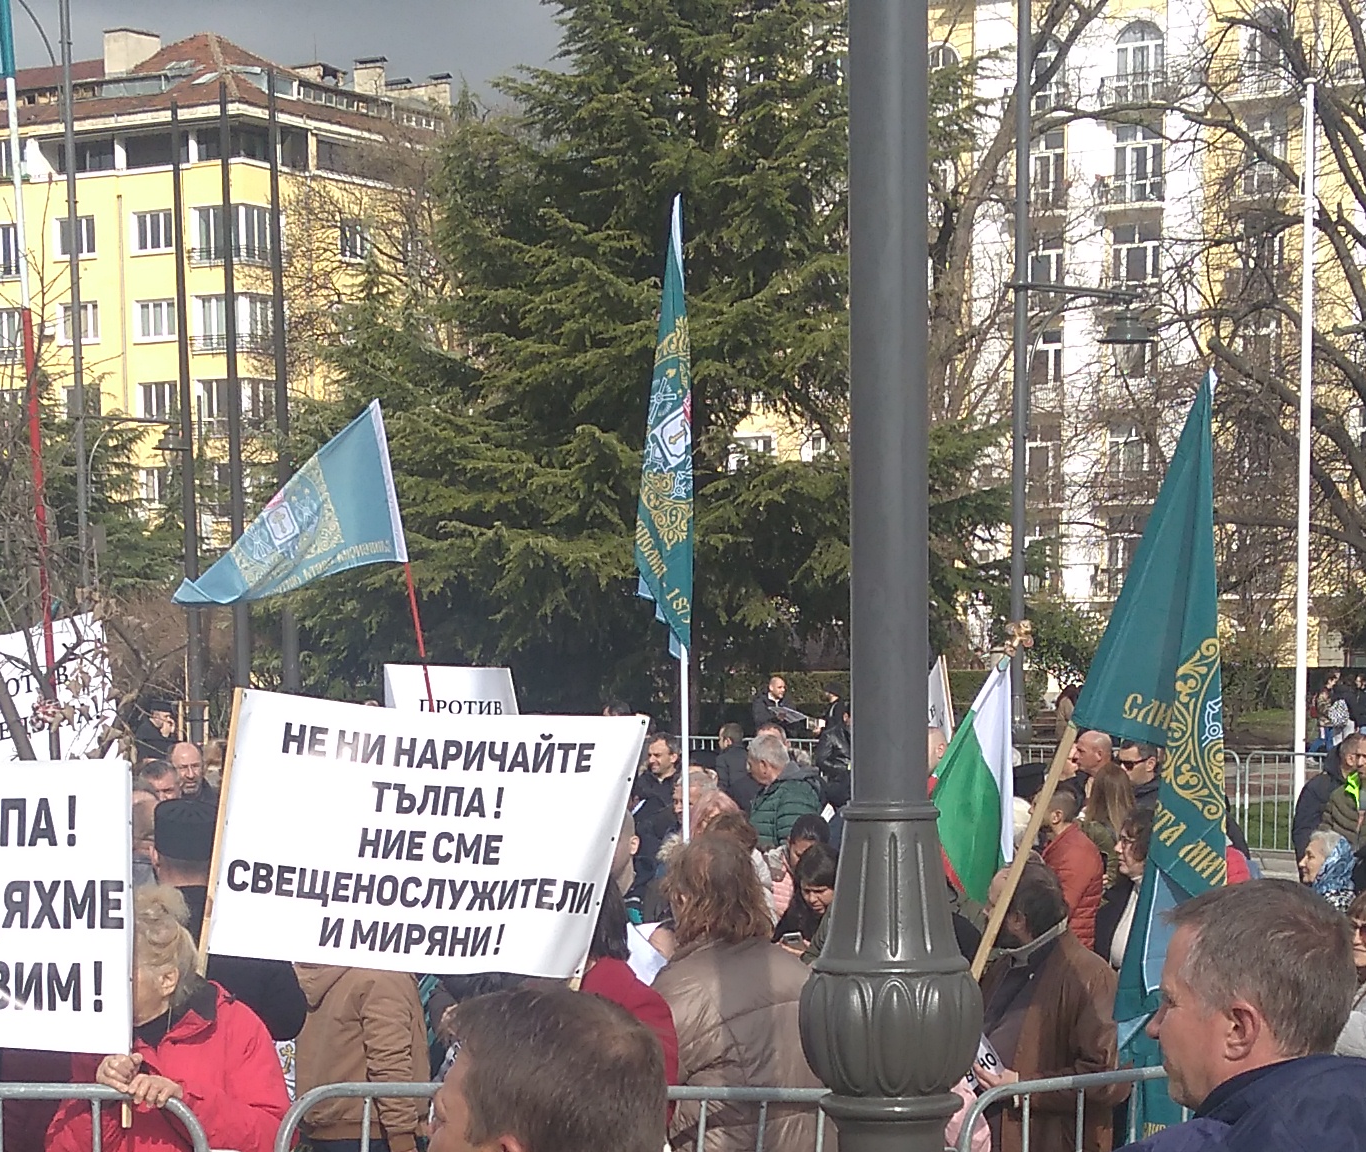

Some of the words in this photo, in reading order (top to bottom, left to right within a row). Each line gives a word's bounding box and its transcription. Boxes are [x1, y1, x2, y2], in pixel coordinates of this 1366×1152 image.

[419, 699, 503, 715] ПРОТИВ
[281, 721, 329, 756] НЕ
[336, 728, 387, 765] НИ
[393, 733, 596, 774] НАРИЧАЙТЕ
[357, 827, 427, 862] НИЕ
[433, 831, 503, 866] СМЕ
[226, 859, 595, 915] СВЕЩЕНОСЛУЖИТЕЛИ
[318, 917, 345, 949] И
[350, 919, 506, 957] МИРЯНИ!
